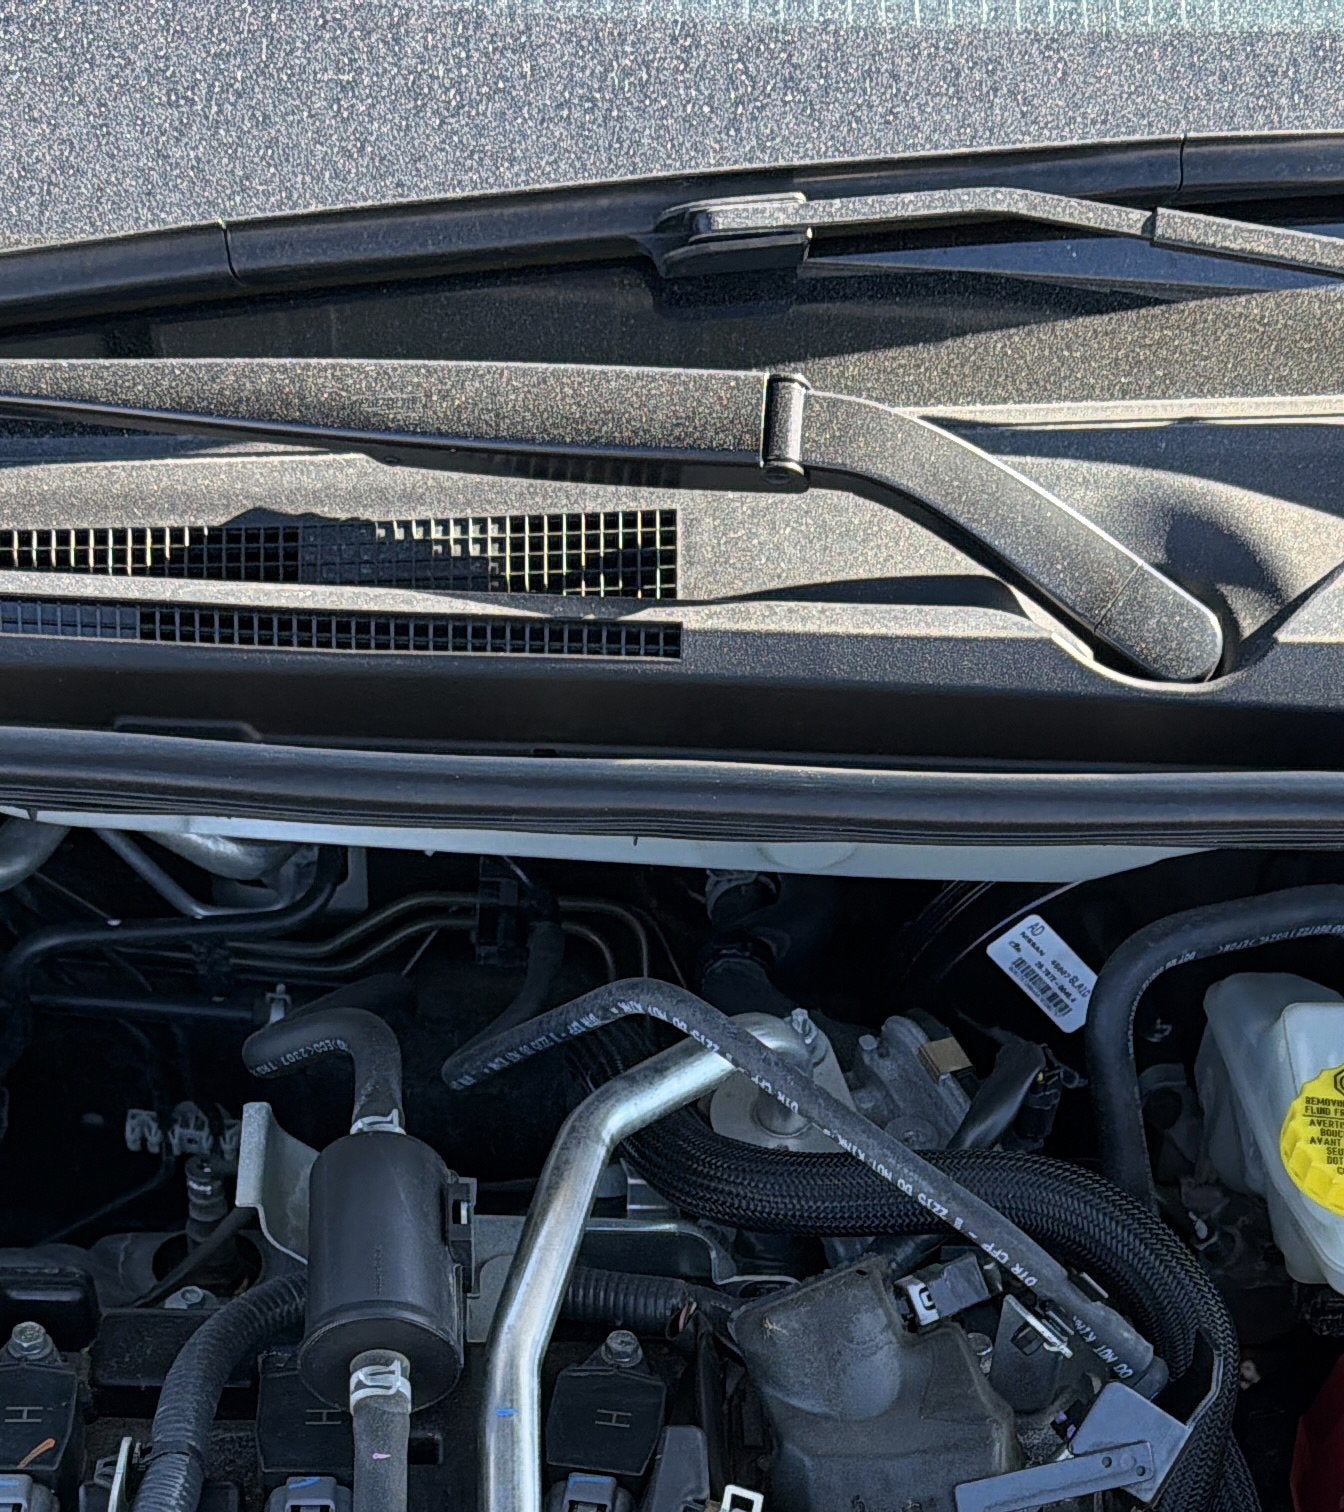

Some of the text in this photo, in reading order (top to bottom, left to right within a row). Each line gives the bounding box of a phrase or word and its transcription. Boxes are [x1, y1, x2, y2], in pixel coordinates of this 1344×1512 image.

[1305, 1107, 1331, 1116] FLUID
[1310, 1137, 1343, 1147] AVANT
[1326, 1156, 1343, 1165] DOT
[872, 1160, 893, 1183] NOT
[897, 1178, 912, 1197] DO
[982, 1242, 1009, 1264] CFP
[1010, 1263, 1038, 1287] DTR
[1094, 1346, 1119, 1364] NOT
[1113, 1362, 1134, 1379] DO
